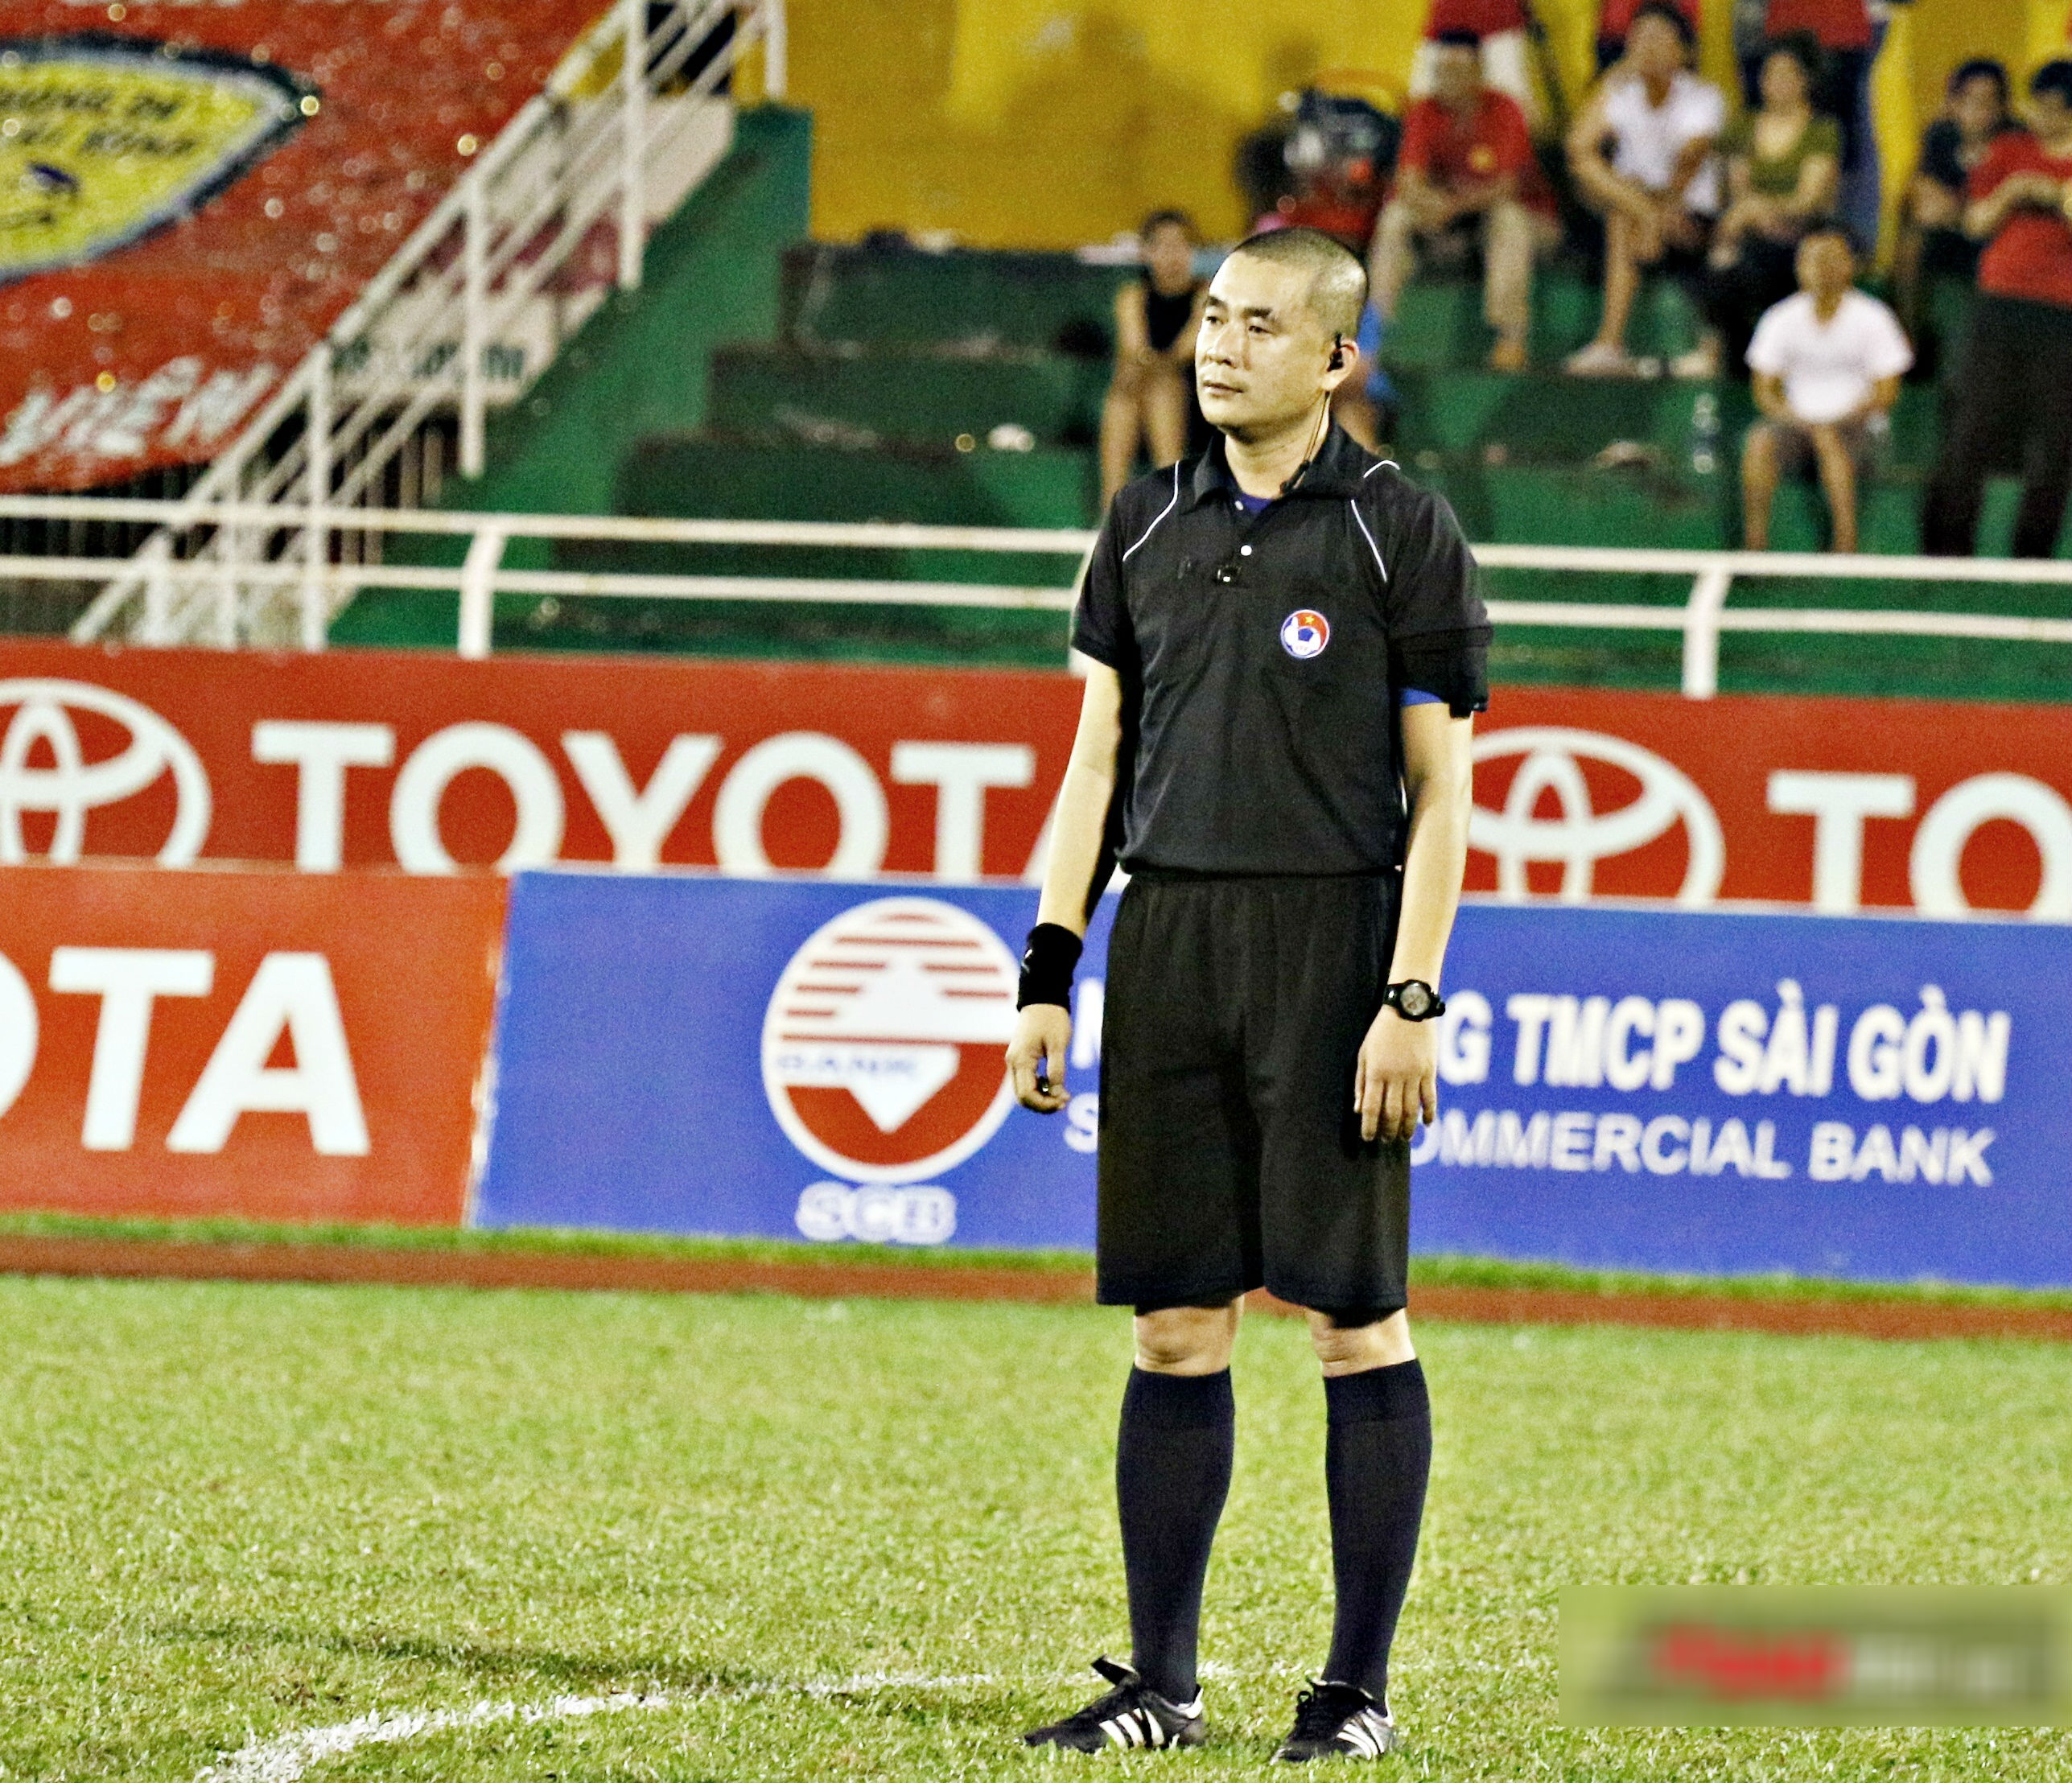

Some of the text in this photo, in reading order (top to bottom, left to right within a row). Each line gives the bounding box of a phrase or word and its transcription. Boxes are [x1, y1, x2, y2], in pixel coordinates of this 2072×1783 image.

[253, 721, 1050, 883] TOYOT
[0, 945, 371, 1156] TA
[1507, 994, 1703, 1089] TMCP
[1715, 979, 1839, 1096] SÀI
[1847, 985, 2011, 1103] GÒN
[1410, 1110, 1996, 1186] MMERCIAL BANK
